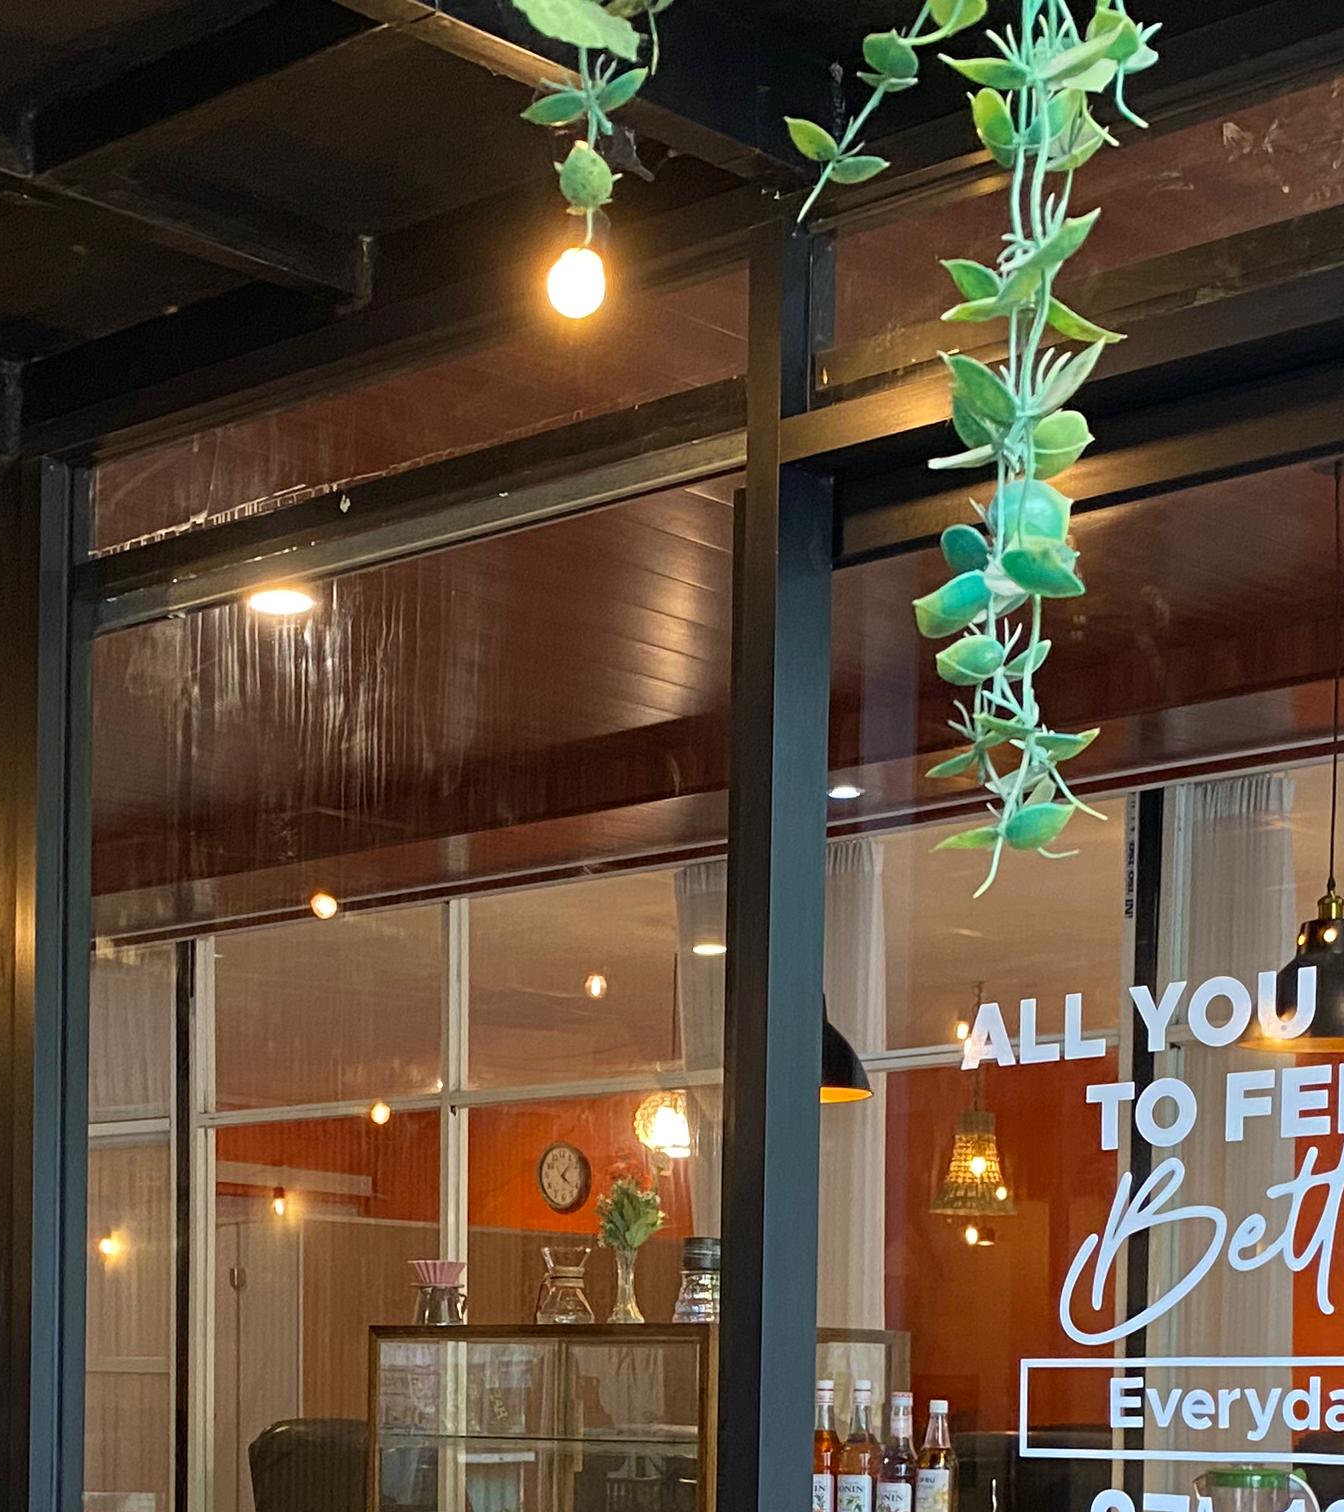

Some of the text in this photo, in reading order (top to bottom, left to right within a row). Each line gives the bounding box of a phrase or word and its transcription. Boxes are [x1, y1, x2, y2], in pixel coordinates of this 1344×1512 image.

[959, 991, 1107, 1071] ALL
[1128, 965, 1318, 1053] YOU
[1085, 1077, 1199, 1151] TO
